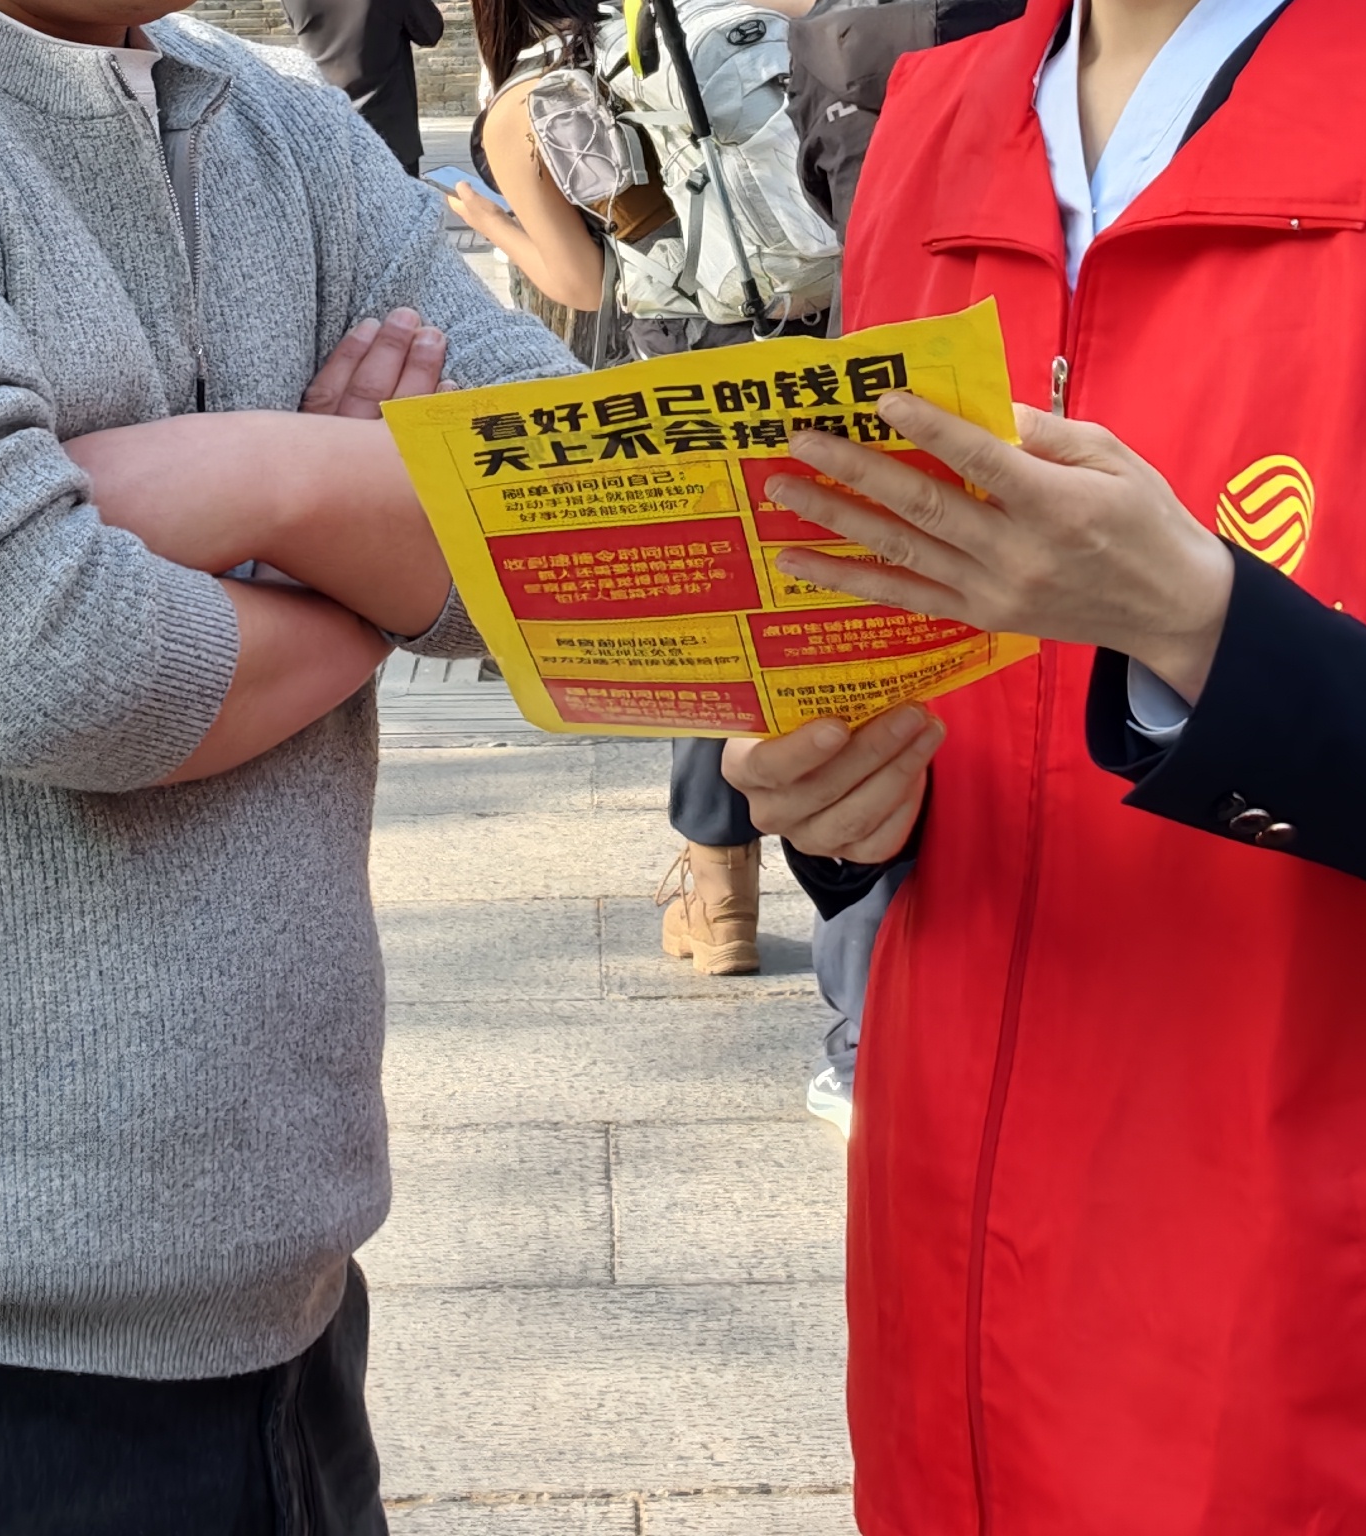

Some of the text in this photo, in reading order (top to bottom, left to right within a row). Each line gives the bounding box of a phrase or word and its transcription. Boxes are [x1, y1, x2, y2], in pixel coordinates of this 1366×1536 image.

[471, 353, 913, 441] 看好自己的钱包
